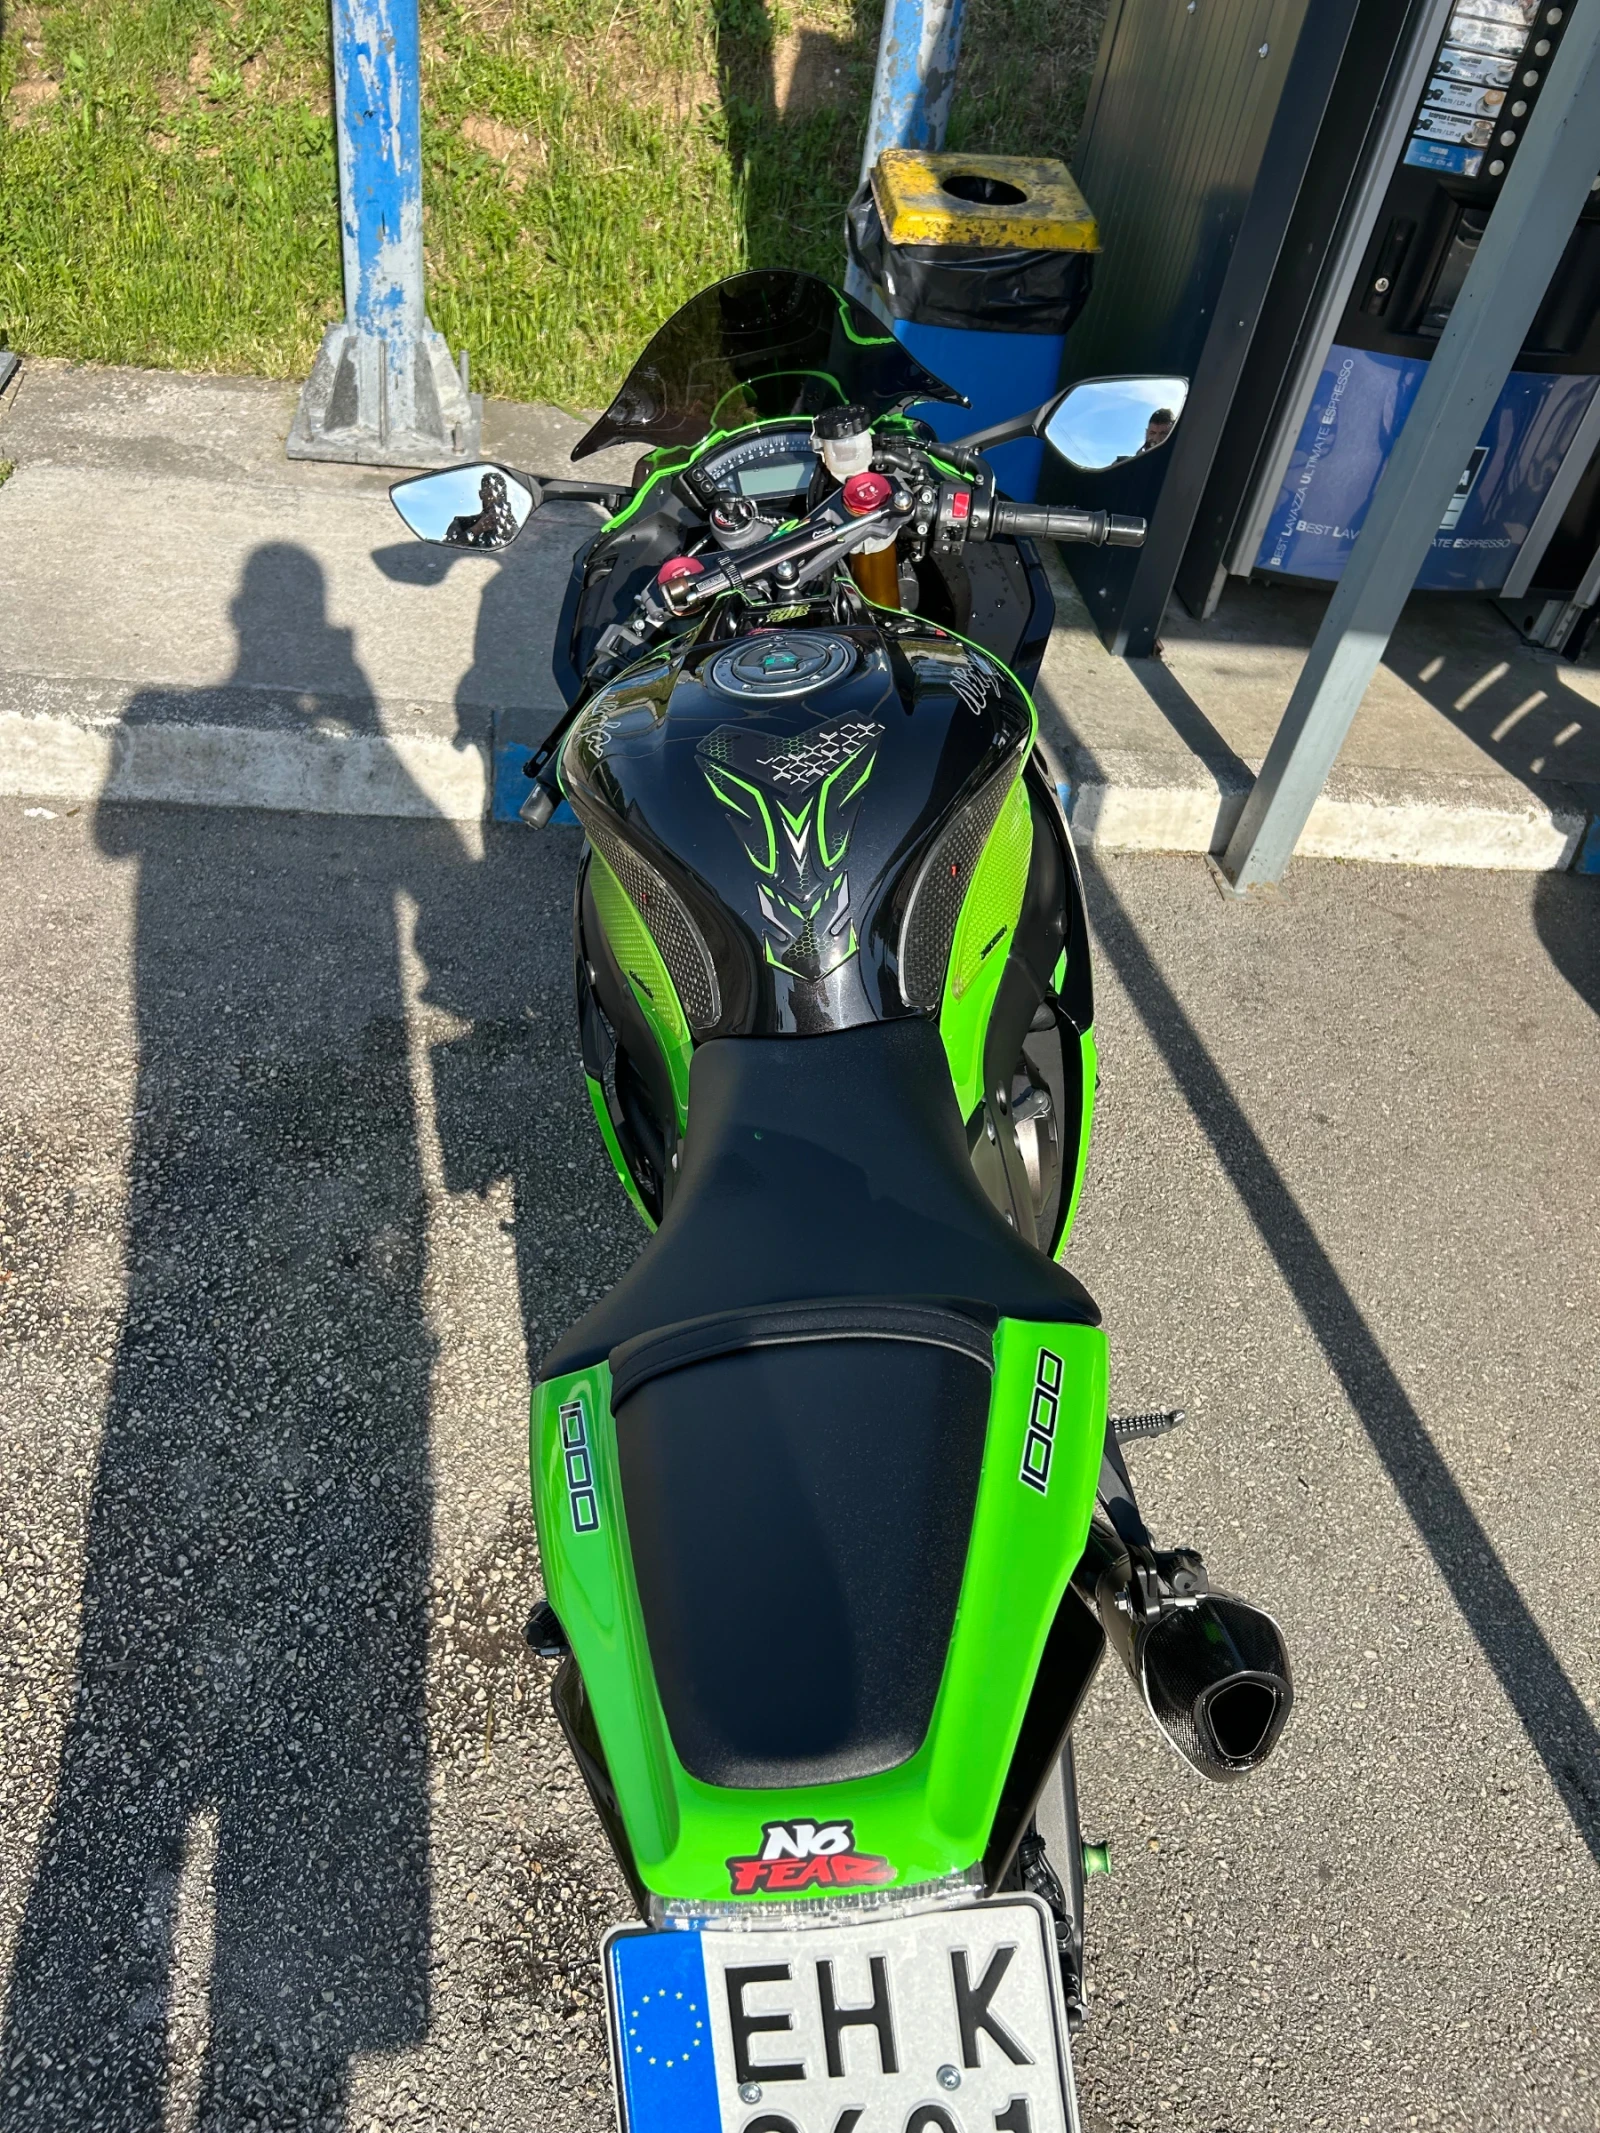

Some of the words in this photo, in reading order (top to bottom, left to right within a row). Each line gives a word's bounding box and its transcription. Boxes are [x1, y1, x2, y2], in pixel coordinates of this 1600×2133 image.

[1270, 538, 1289, 566] BEST
[1281, 487, 1308, 537] LAVAZZA
[1300, 427, 1331, 485] ULTIMATE
[1322, 359, 1354, 425] ESPRESSO
[1296, 520, 1334, 536] BEST
[1453, 538, 1511, 549] ESPRESSO
[558, 1400, 600, 1534] 1000
[1019, 1346, 1065, 1497] 1000
[732, 1856, 896, 1891] FEAR
[762, 1822, 850, 1860] NO
[949, 1943, 1036, 2069] K
